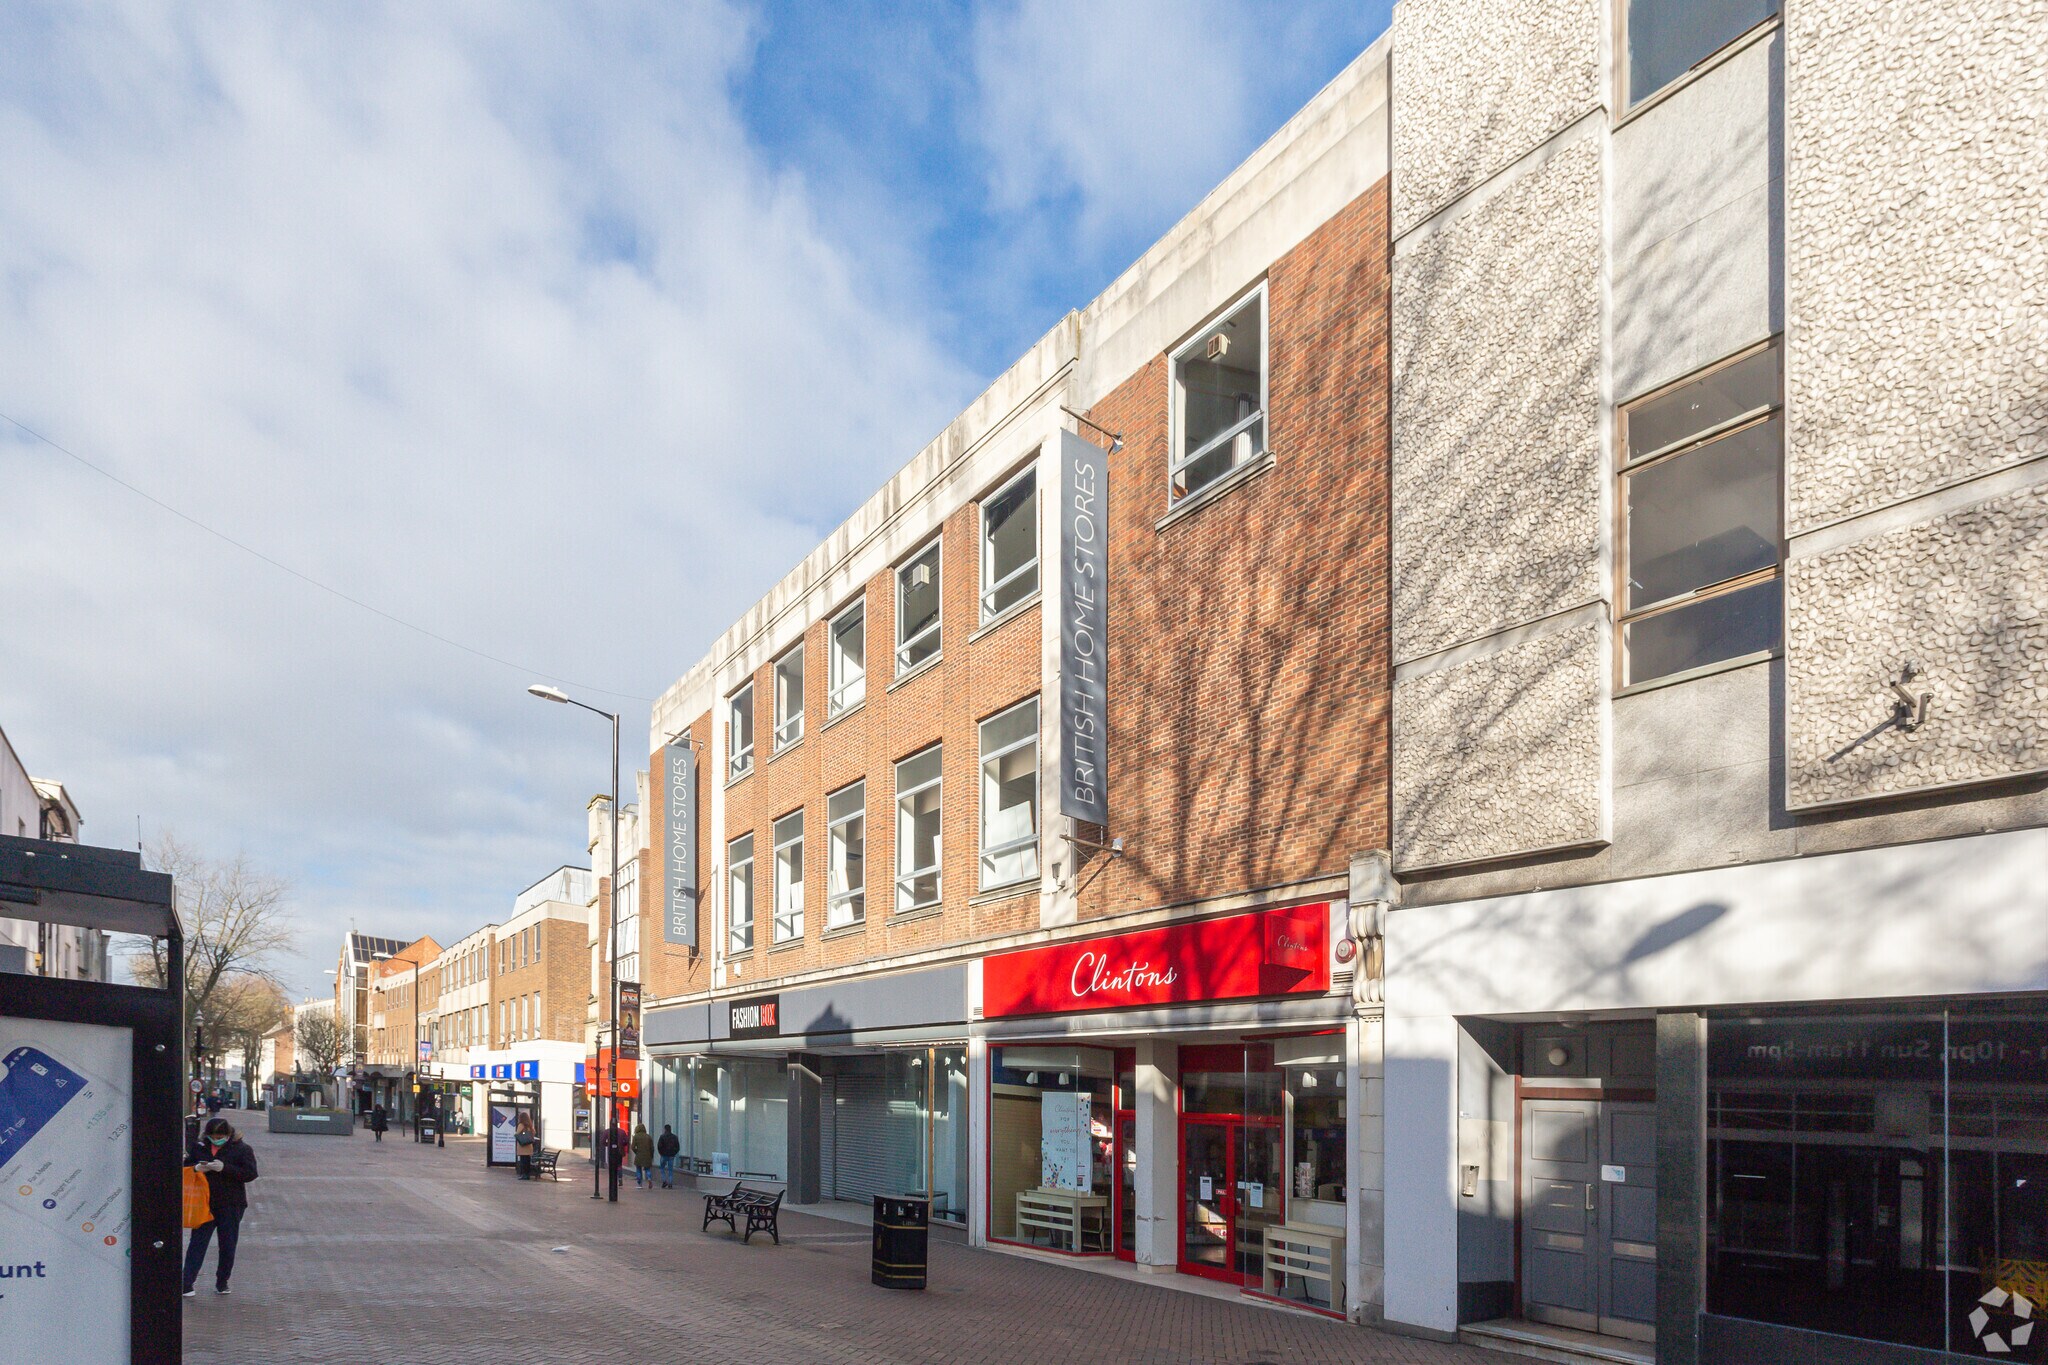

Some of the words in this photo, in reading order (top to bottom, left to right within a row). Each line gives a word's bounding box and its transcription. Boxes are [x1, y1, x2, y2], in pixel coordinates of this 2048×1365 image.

[1074, 458, 1095, 578] STORES
[1074, 582, 1095, 681] HOME
[1074, 684, 1095, 805] BRITISH
[673, 757, 687, 818] STORES
[673, 821, 687, 872] HOME
[673, 876, 687, 936] BRITISH
[1070, 951, 1178, 997] Clintons
[732, 1005, 760, 1030] FASHION
[760, 1003, 776, 1027] BOX
